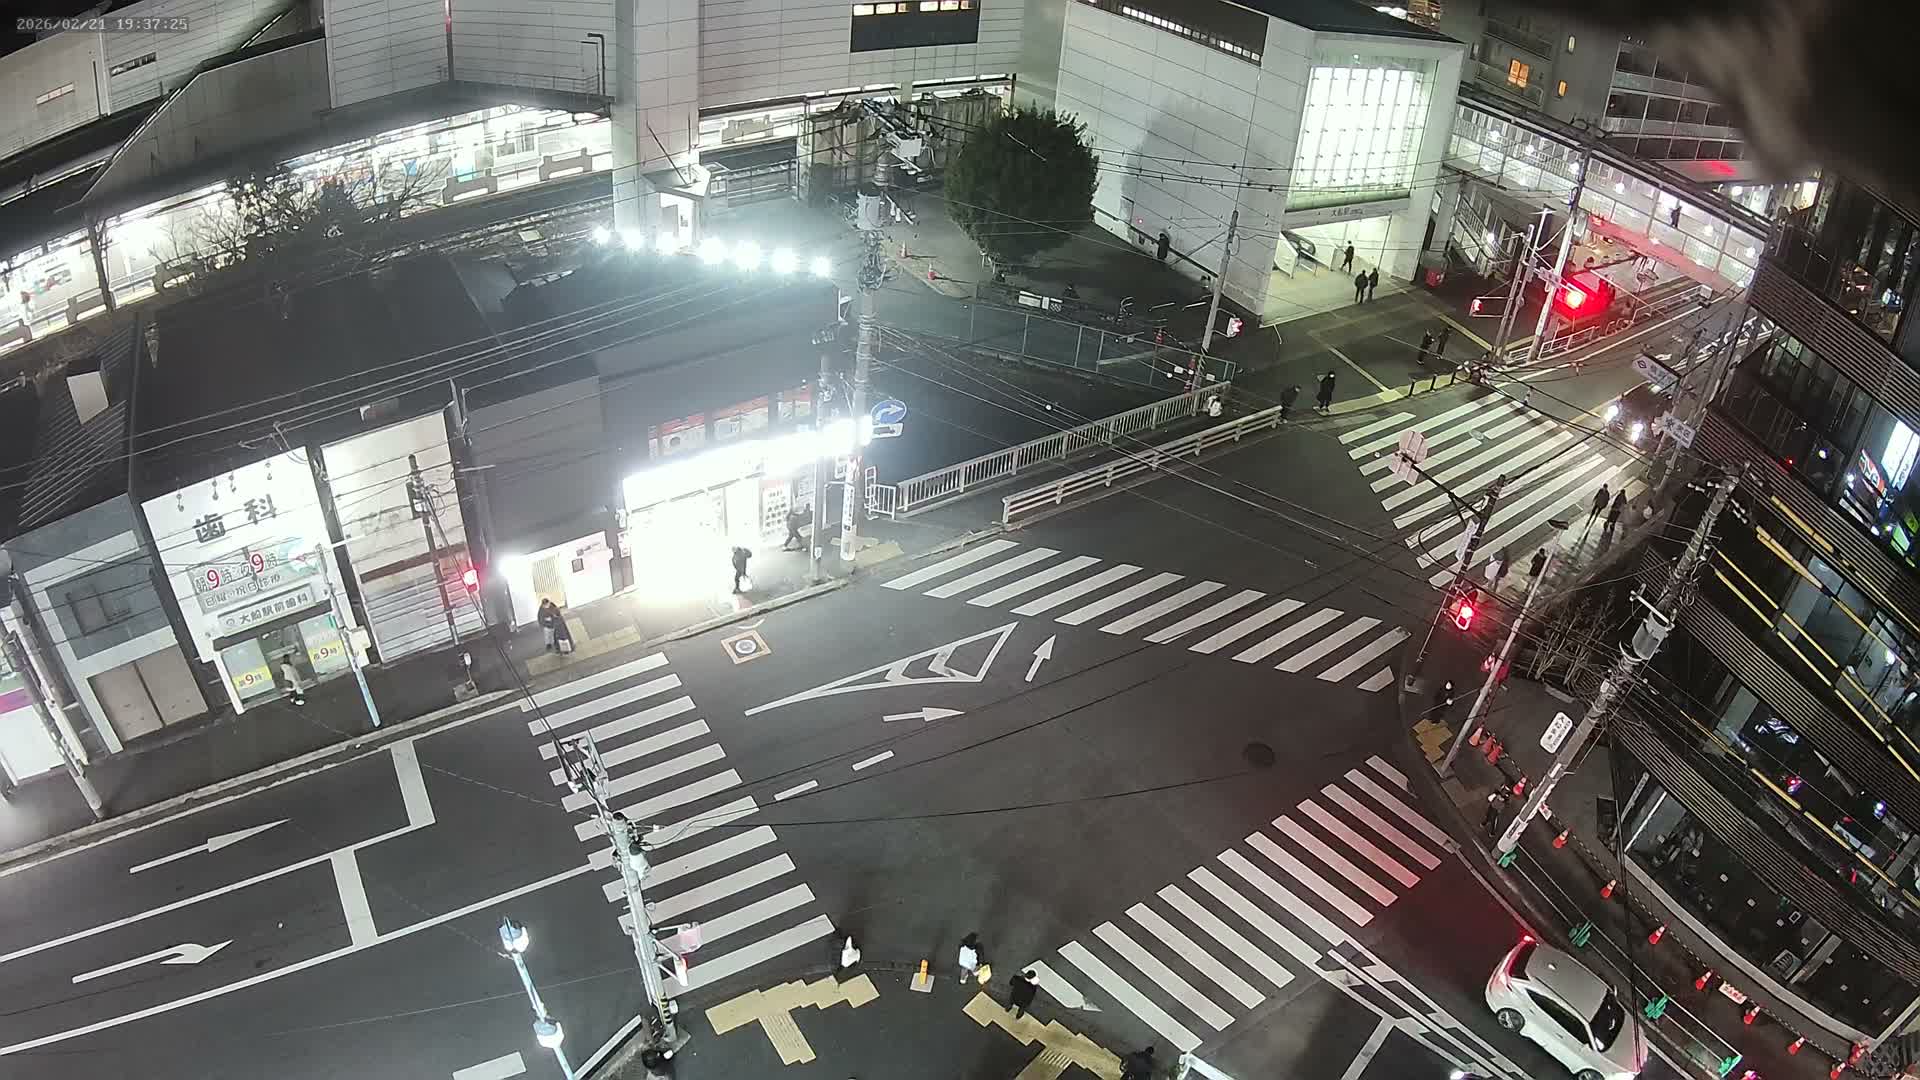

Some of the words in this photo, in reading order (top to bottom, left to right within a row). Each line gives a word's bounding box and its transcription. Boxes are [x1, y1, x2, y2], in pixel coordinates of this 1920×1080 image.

[192, 493, 278, 543] 歯科
[239, 592, 308, 625] 大船駅前歯科
